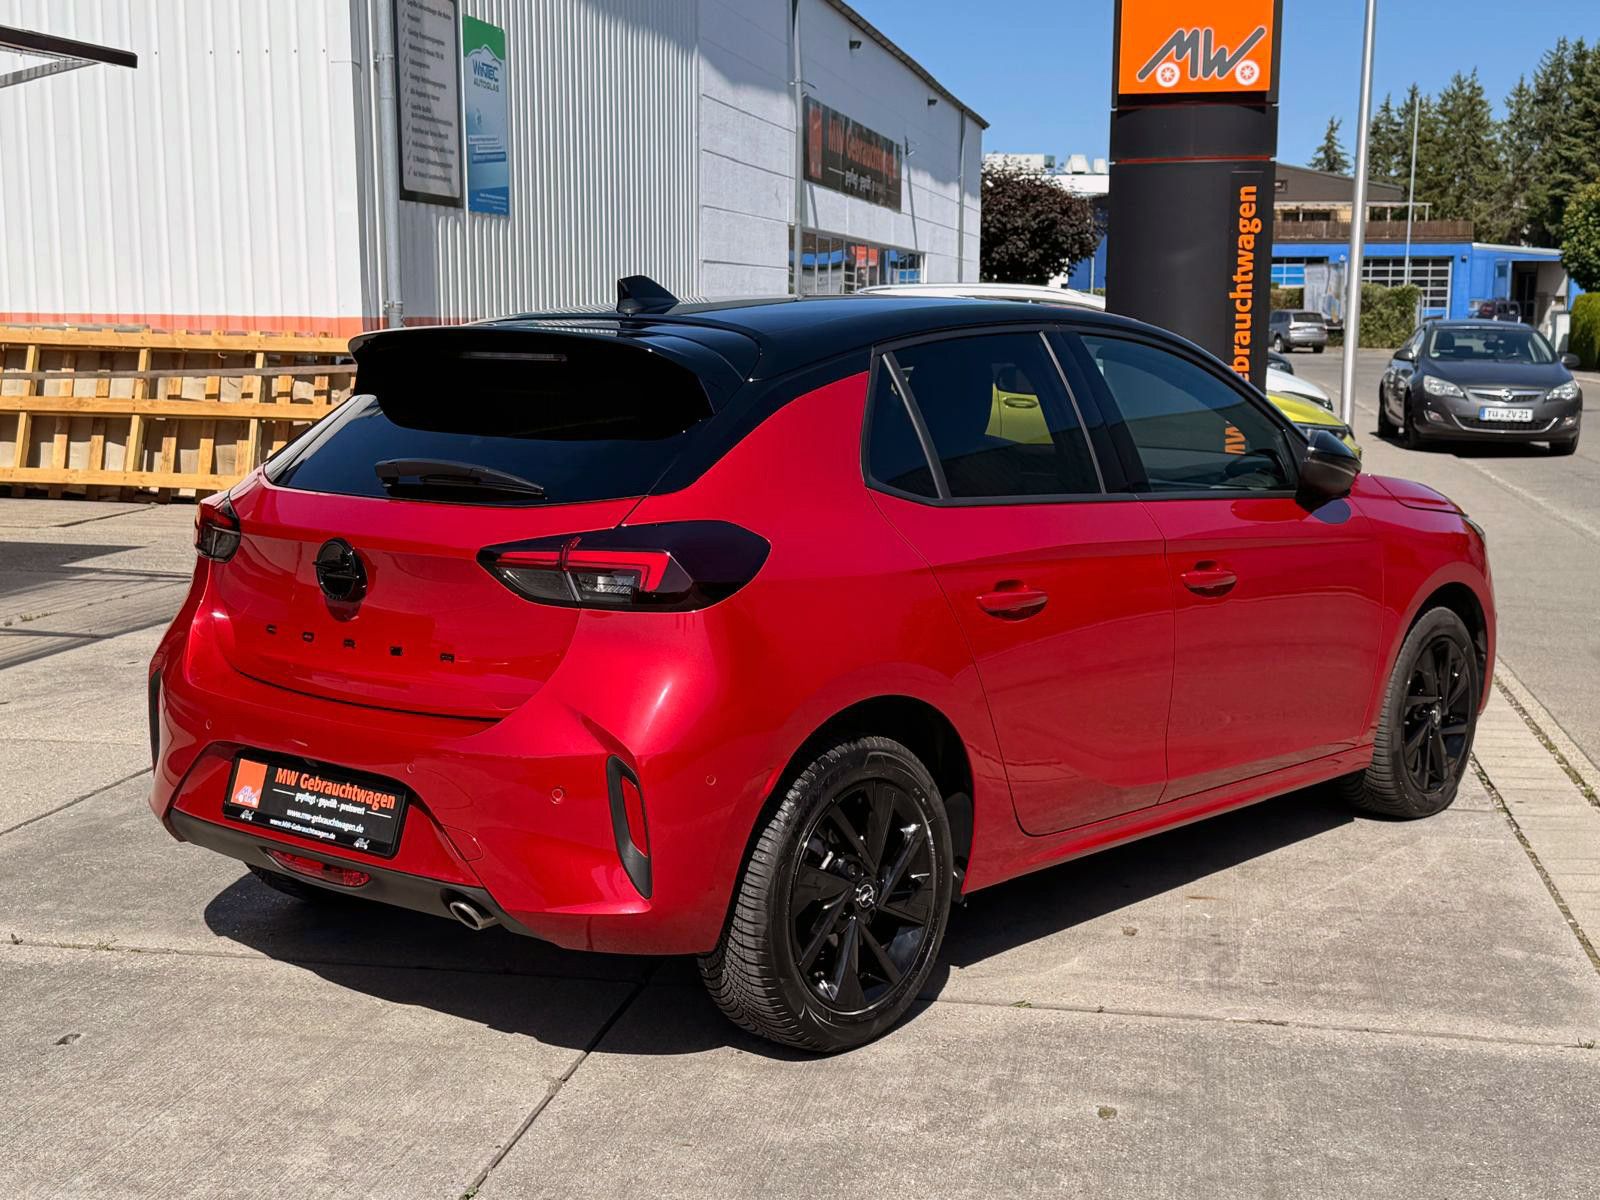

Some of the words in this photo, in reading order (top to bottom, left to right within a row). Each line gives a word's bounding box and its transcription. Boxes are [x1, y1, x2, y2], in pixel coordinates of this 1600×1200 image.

[1137, 26, 1266, 87] MW
[274, 767, 300, 787] MW
[299, 773, 396, 811] Gebrauchtwagen
